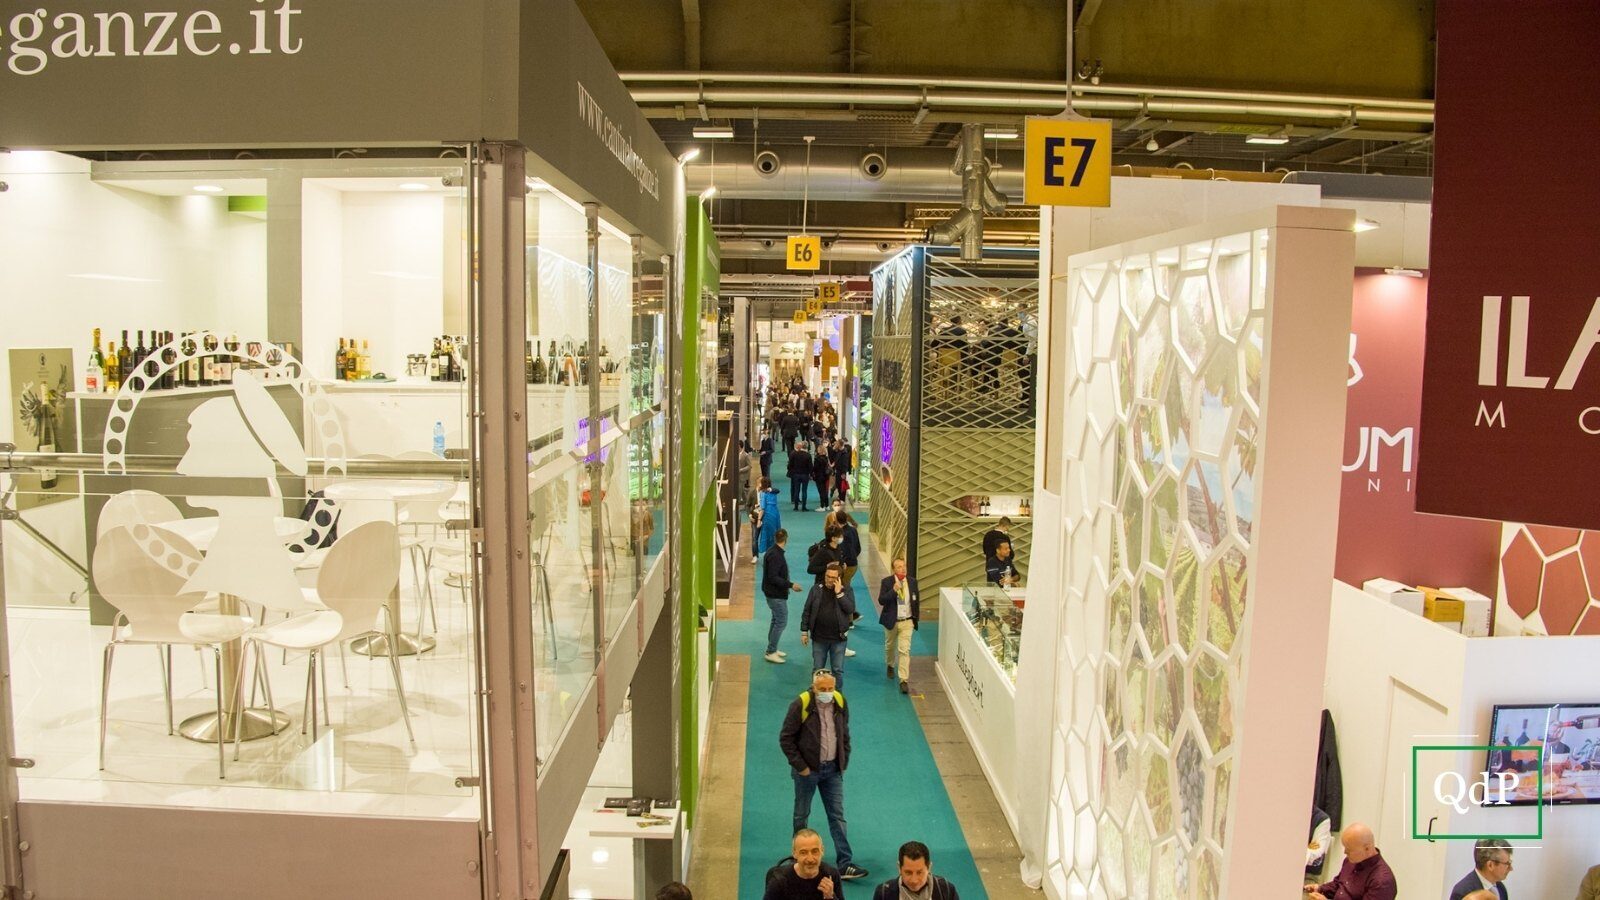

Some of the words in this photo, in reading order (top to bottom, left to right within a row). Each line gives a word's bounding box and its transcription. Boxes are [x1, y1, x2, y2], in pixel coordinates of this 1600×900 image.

[0, 0, 303, 76] ganze.it
[1044, 136, 1097, 187] E7
[794, 243, 812, 261] E6
[823, 287, 835, 298] E5
[809, 302, 818, 310] E4
